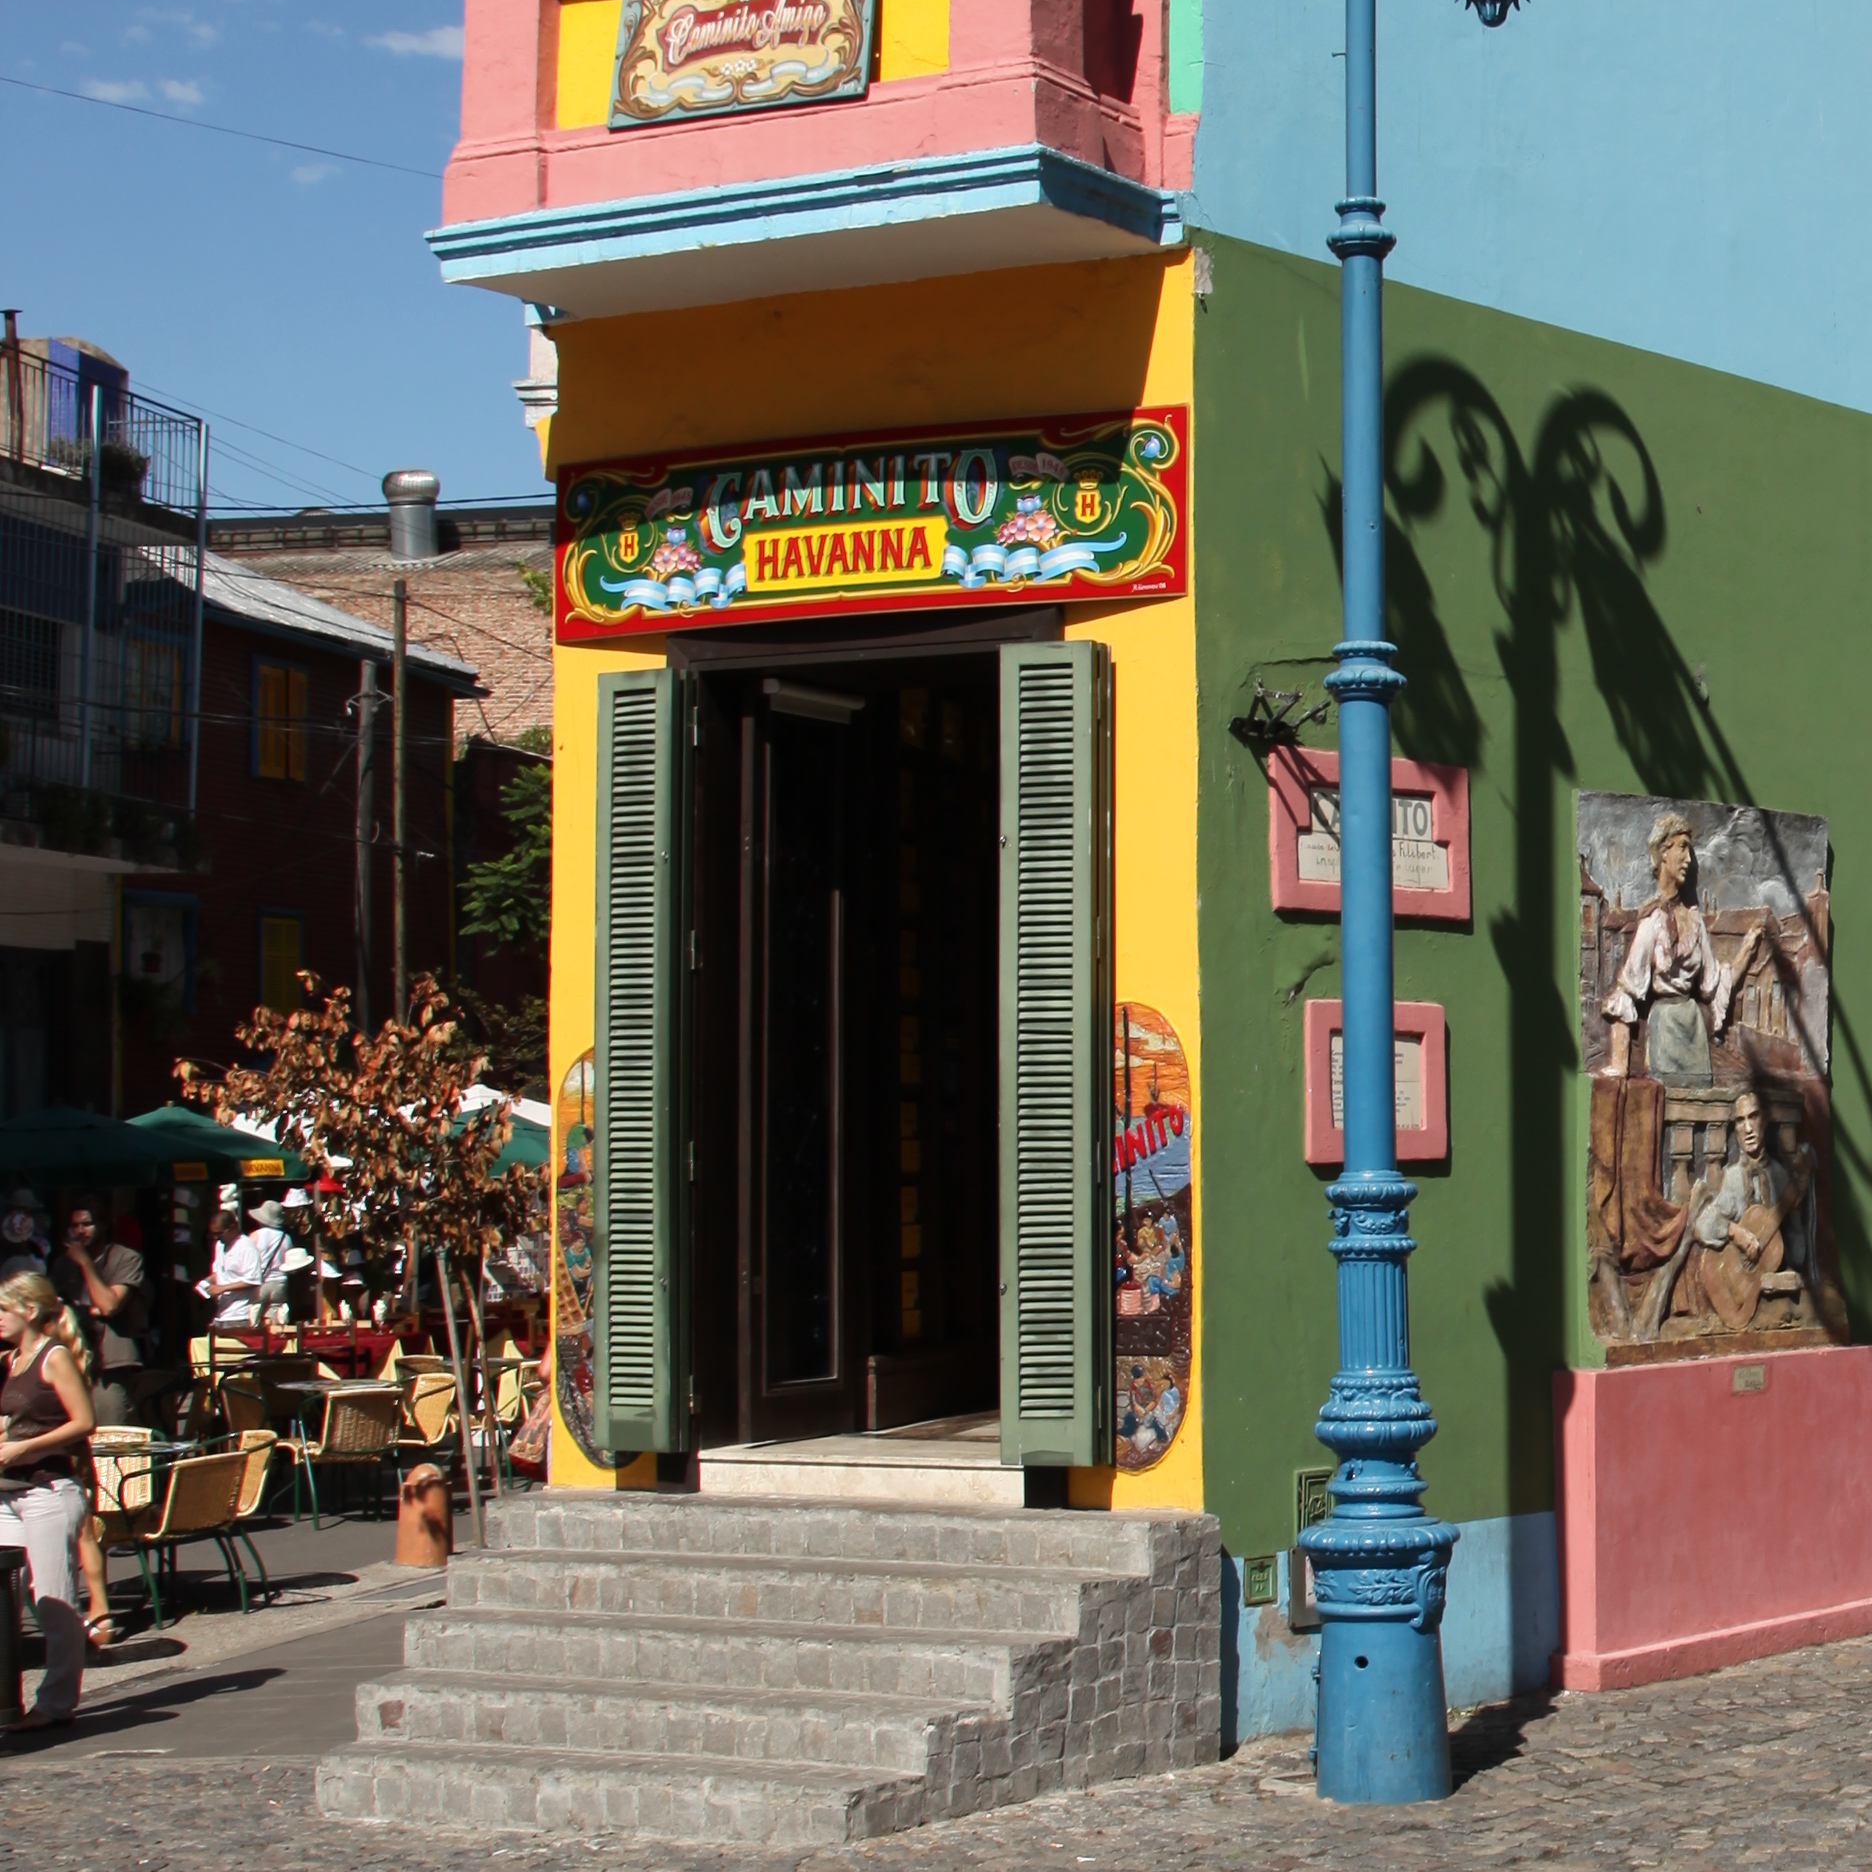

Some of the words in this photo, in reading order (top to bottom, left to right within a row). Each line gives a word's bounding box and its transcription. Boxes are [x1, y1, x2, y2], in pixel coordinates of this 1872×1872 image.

[666, 5, 760, 65] Caminito
[703, 449, 999, 550] CAMINITO
[1080, 494, 1096, 517] H
[623, 534, 636, 557] H
[755, 526, 932, 582] HAVANNA
